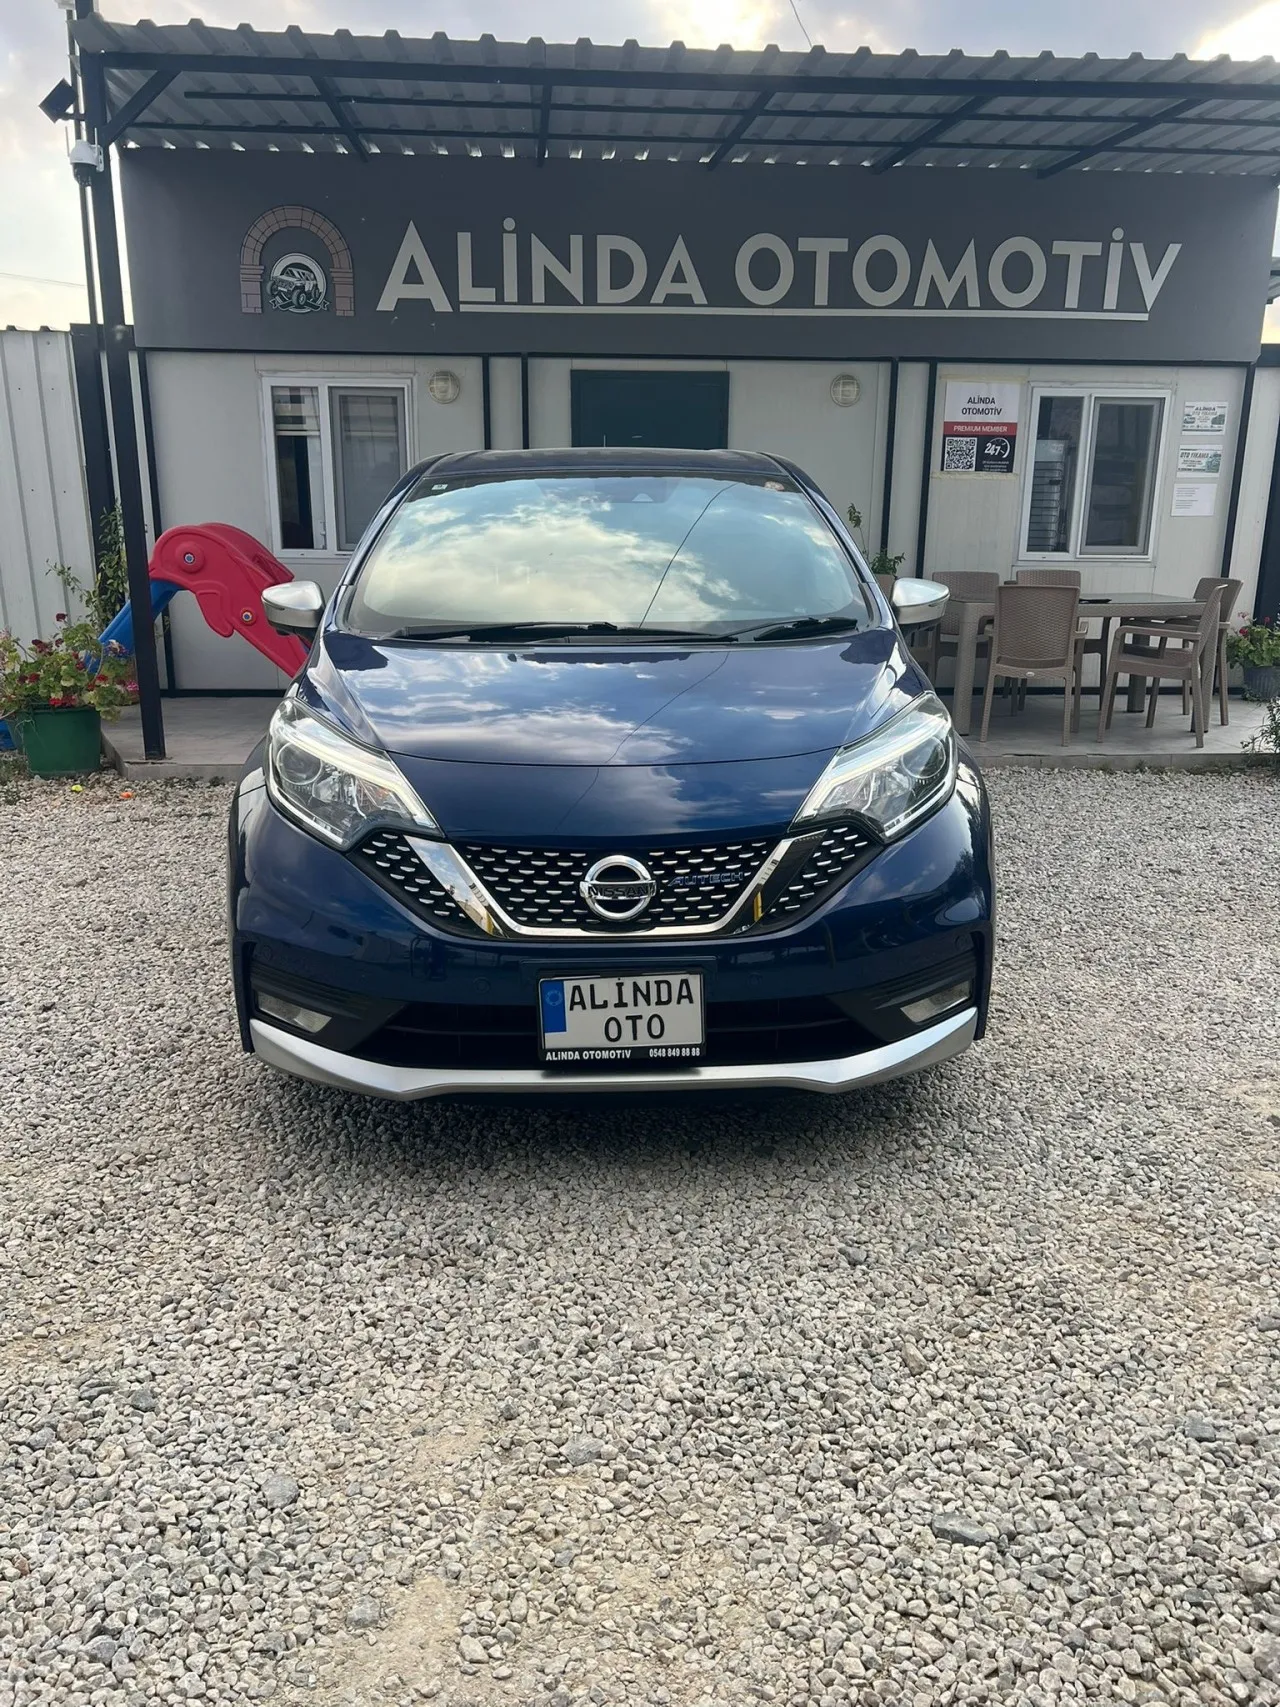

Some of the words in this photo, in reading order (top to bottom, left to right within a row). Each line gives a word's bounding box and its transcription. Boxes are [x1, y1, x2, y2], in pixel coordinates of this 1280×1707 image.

[376, 217, 708, 313] ALİNDA
[734, 226, 1183, 313] OTOMOTİV
[967, 394, 996, 405] ALİNDA
[961, 406, 1002, 416] OTOMOTİV
[953, 425, 981, 433] PREMIUM
[668, 872, 744, 887] AUTECH
[587, 884, 650, 898] NISSAN
[569, 977, 694, 1012] ALİNDA
[604, 1013, 666, 1043] OTO
[649, 1048, 666, 1058] 0548
[667, 1048, 680, 1058] 849
[681, 1048, 691, 1057] 88
[691, 1047, 701, 1057] 88
